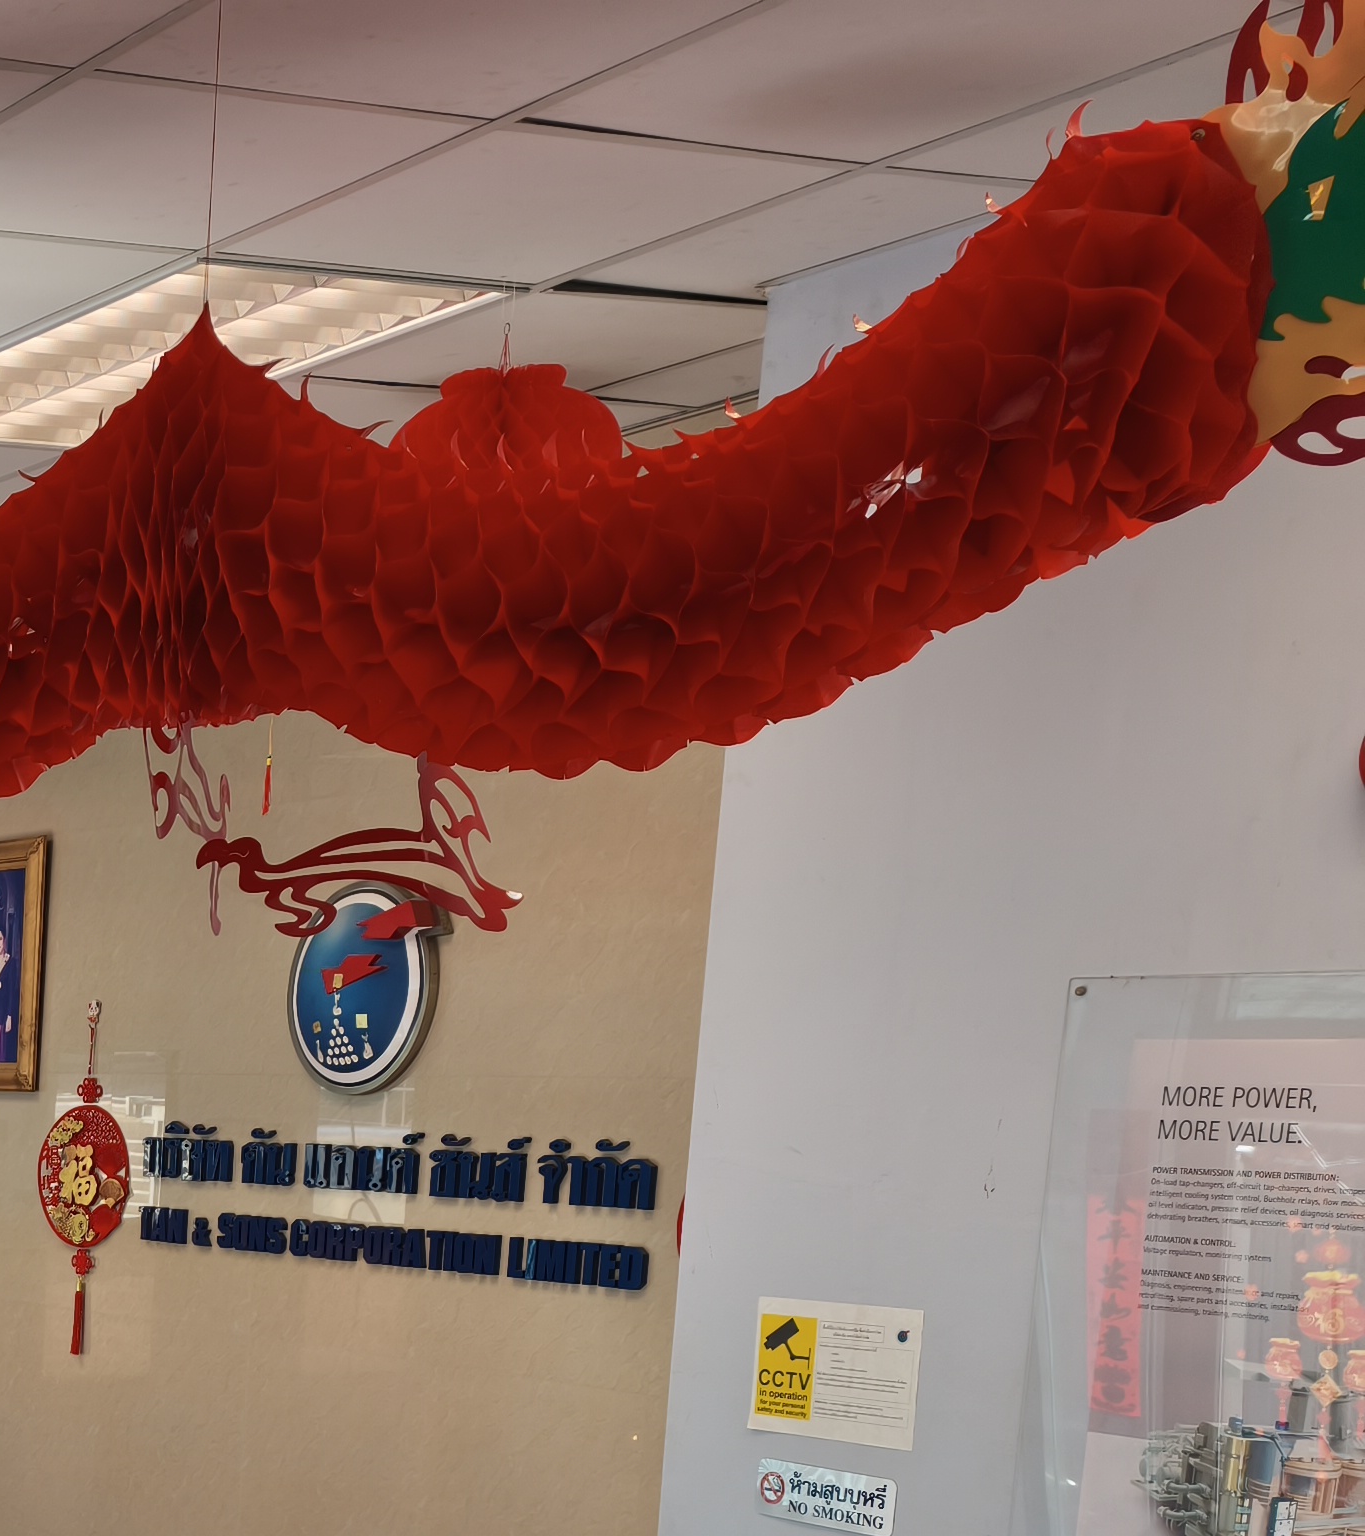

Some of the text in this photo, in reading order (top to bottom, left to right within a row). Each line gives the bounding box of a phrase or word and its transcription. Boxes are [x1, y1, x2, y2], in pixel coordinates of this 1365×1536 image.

[1161, 1086, 1317, 1113] MORE POWER,
[1157, 1119, 1302, 1144] MORE VALUE.
[142, 1120, 234, 1183] บริษัท
[537, 1138, 659, 1210] จำกัด
[1152, 1166, 1339, 1182] POWER TRANSMISSION AND POWER DISTRIBUTION:
[1179, 1180, 1225, 1189] tap-changers,
[1263, 1184, 1312, 1193] tap-changers,
[1314, 1186, 1337, 1194] drives,
[1184, 1192, 1209, 1200] cooling
[1297, 1197, 1321, 1206] relays,
[1211, 1205, 1239, 1213] pressure
[1260, 1207, 1288, 1216] devices,
[1289, 1208, 1299, 1216] oil
[1300, 1210, 1334, 1218] diagnosis
[139, 1206, 650, 1291] TAN & SONS CORPORATION LIMITED
[1144, 1235, 1191, 1245] AUTOMATION
[1141, 1268, 1192, 1280] MAINTENANCE
[1193, 1272, 1210, 1281] AND
[759, 1369, 811, 1390] CCTV
[759, 1388, 808, 1402] in operation
[788, 1471, 888, 1510] ห้ามสูบบุหรี่
[787, 1500, 884, 1530] NO SMOKING
